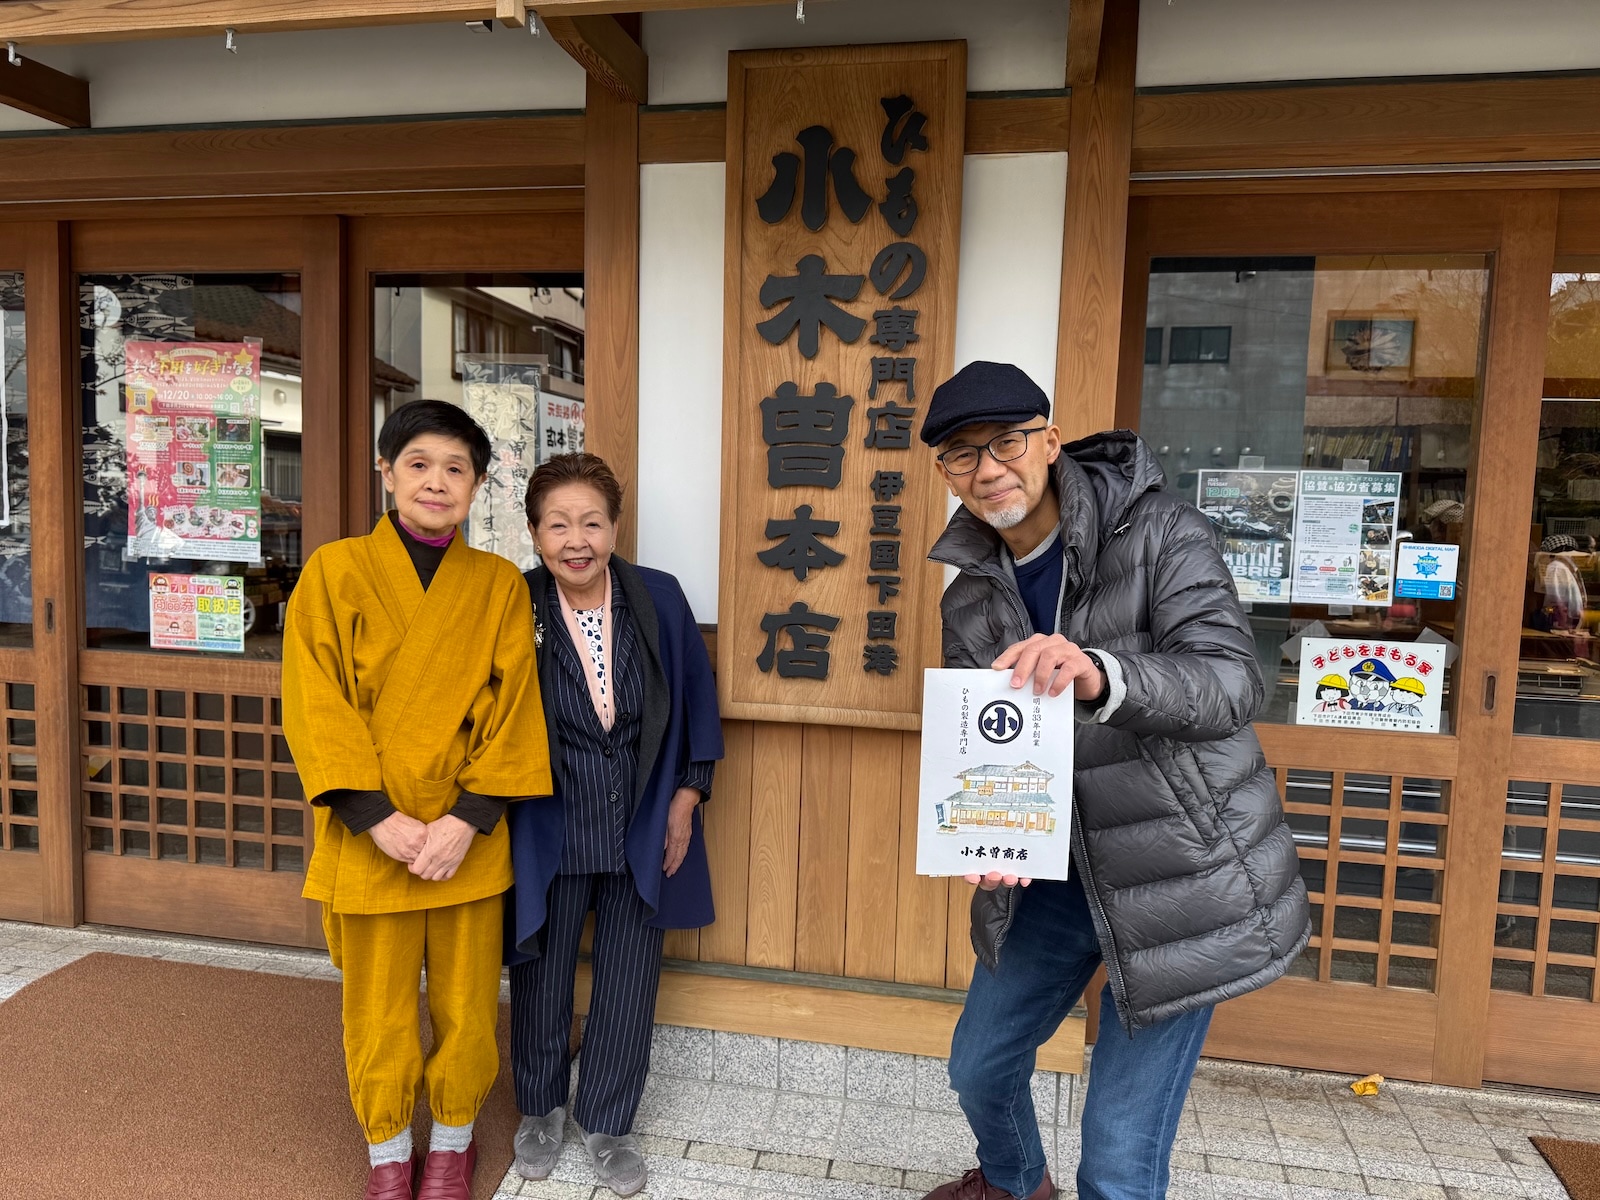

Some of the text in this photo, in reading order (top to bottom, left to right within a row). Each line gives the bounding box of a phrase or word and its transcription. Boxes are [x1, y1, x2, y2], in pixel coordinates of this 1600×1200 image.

[163, 390, 190, 400] 12/20
[756, 125, 873, 681] 小木曽本店
[1217, 541, 1284, 567] ARINE
[1311, 644, 1433, 676] 子どもをまもる家
[959, 687, 969, 754] ひもの製造専門店
[1031, 697, 1042, 747] 明治33年創業
